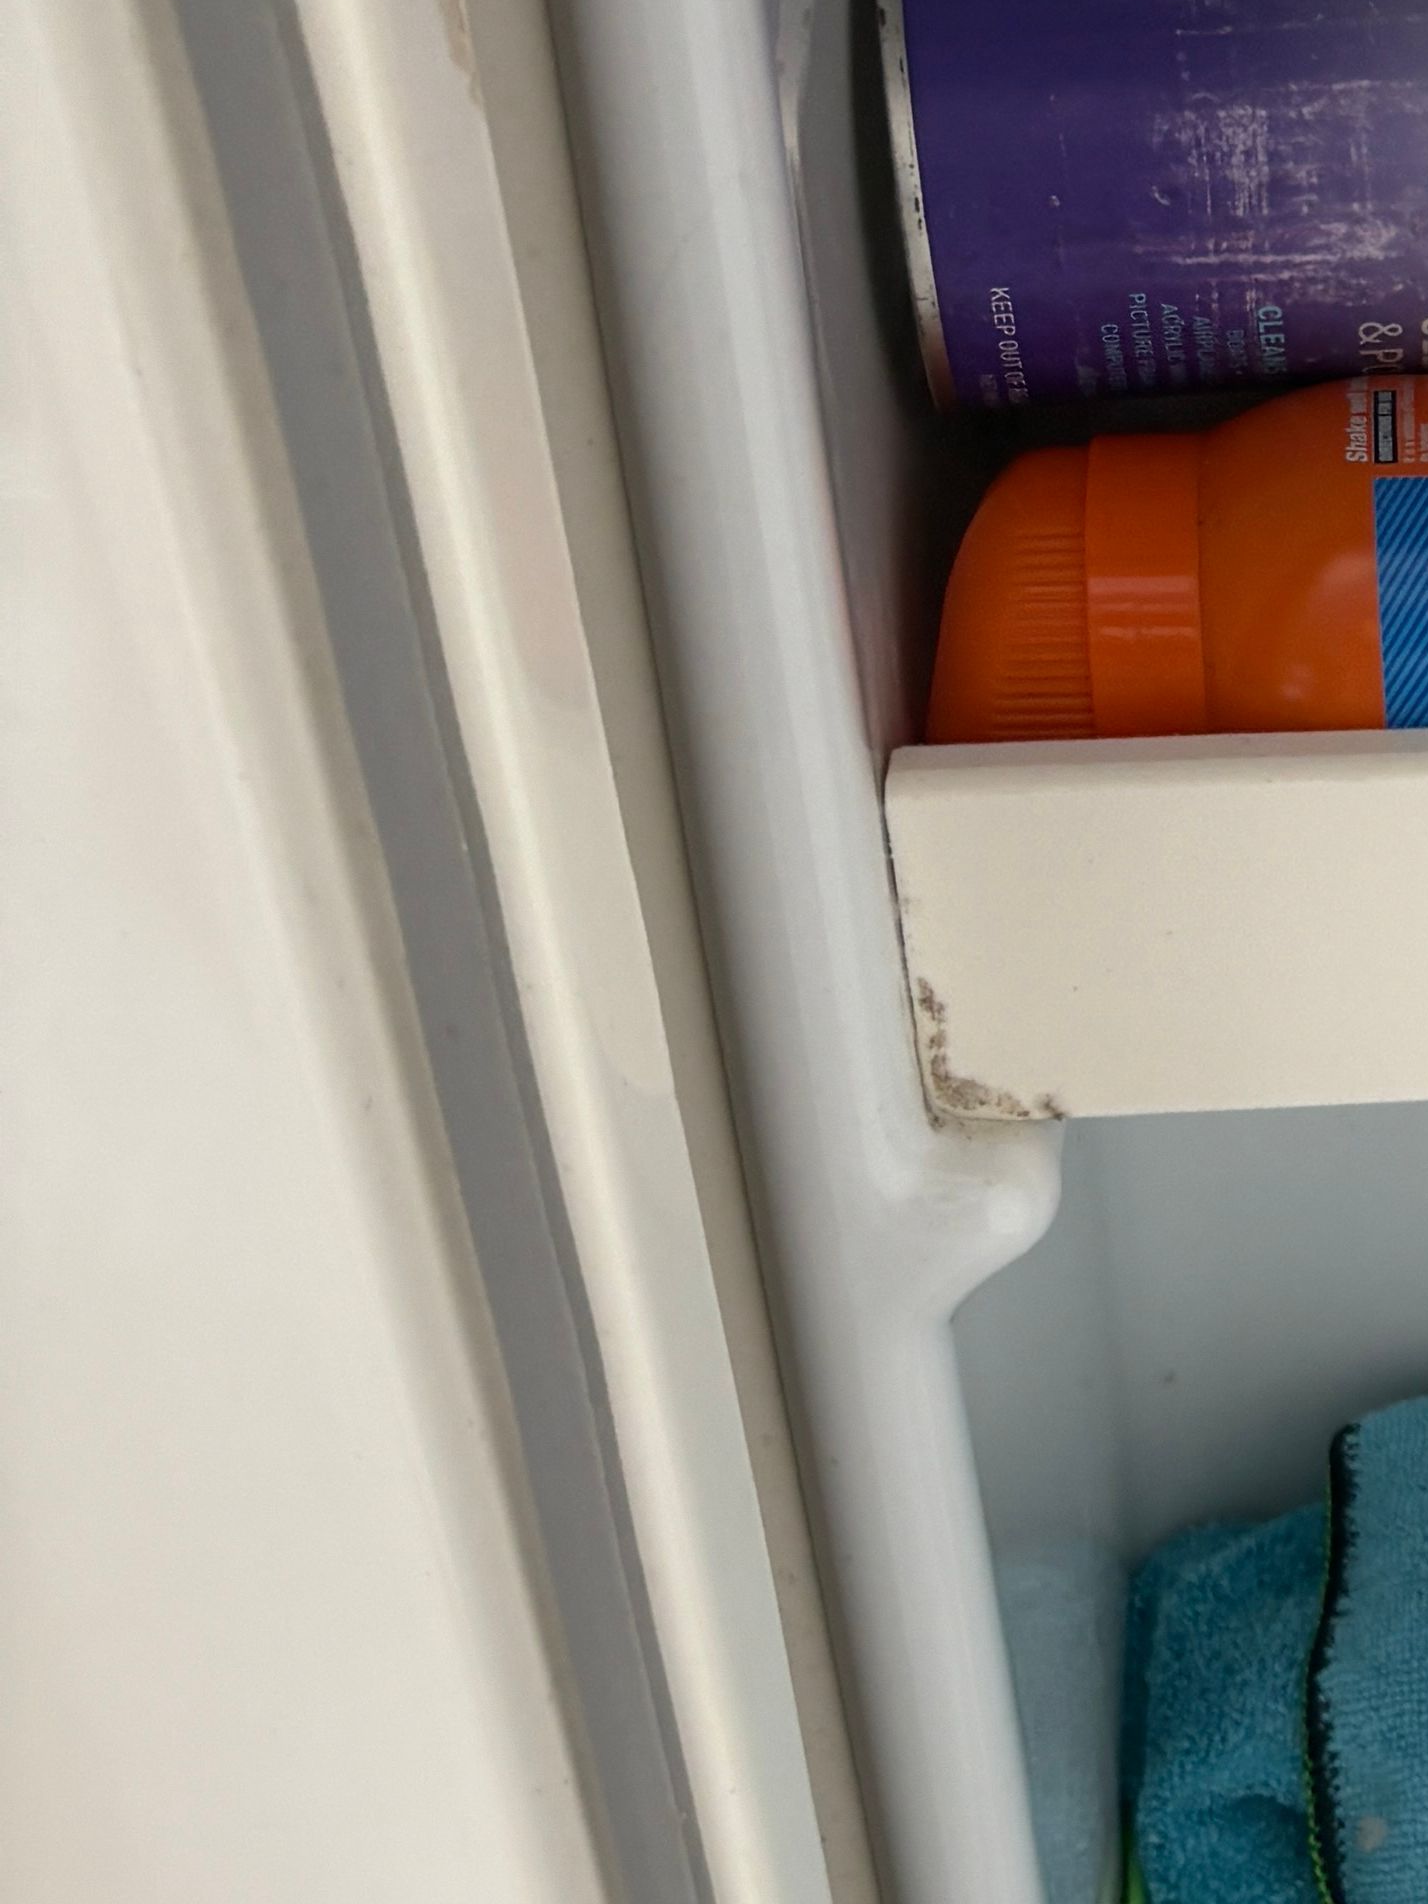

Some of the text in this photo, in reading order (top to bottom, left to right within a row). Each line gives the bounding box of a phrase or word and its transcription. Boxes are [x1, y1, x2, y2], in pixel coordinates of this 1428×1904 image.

[989, 287, 1016, 336] KEEP
[1129, 293, 1155, 359] PICTURE
[1358, 322, 1403, 345] &
[998, 340, 1023, 372] OUT
[1345, 415, 1368, 463] Shake
